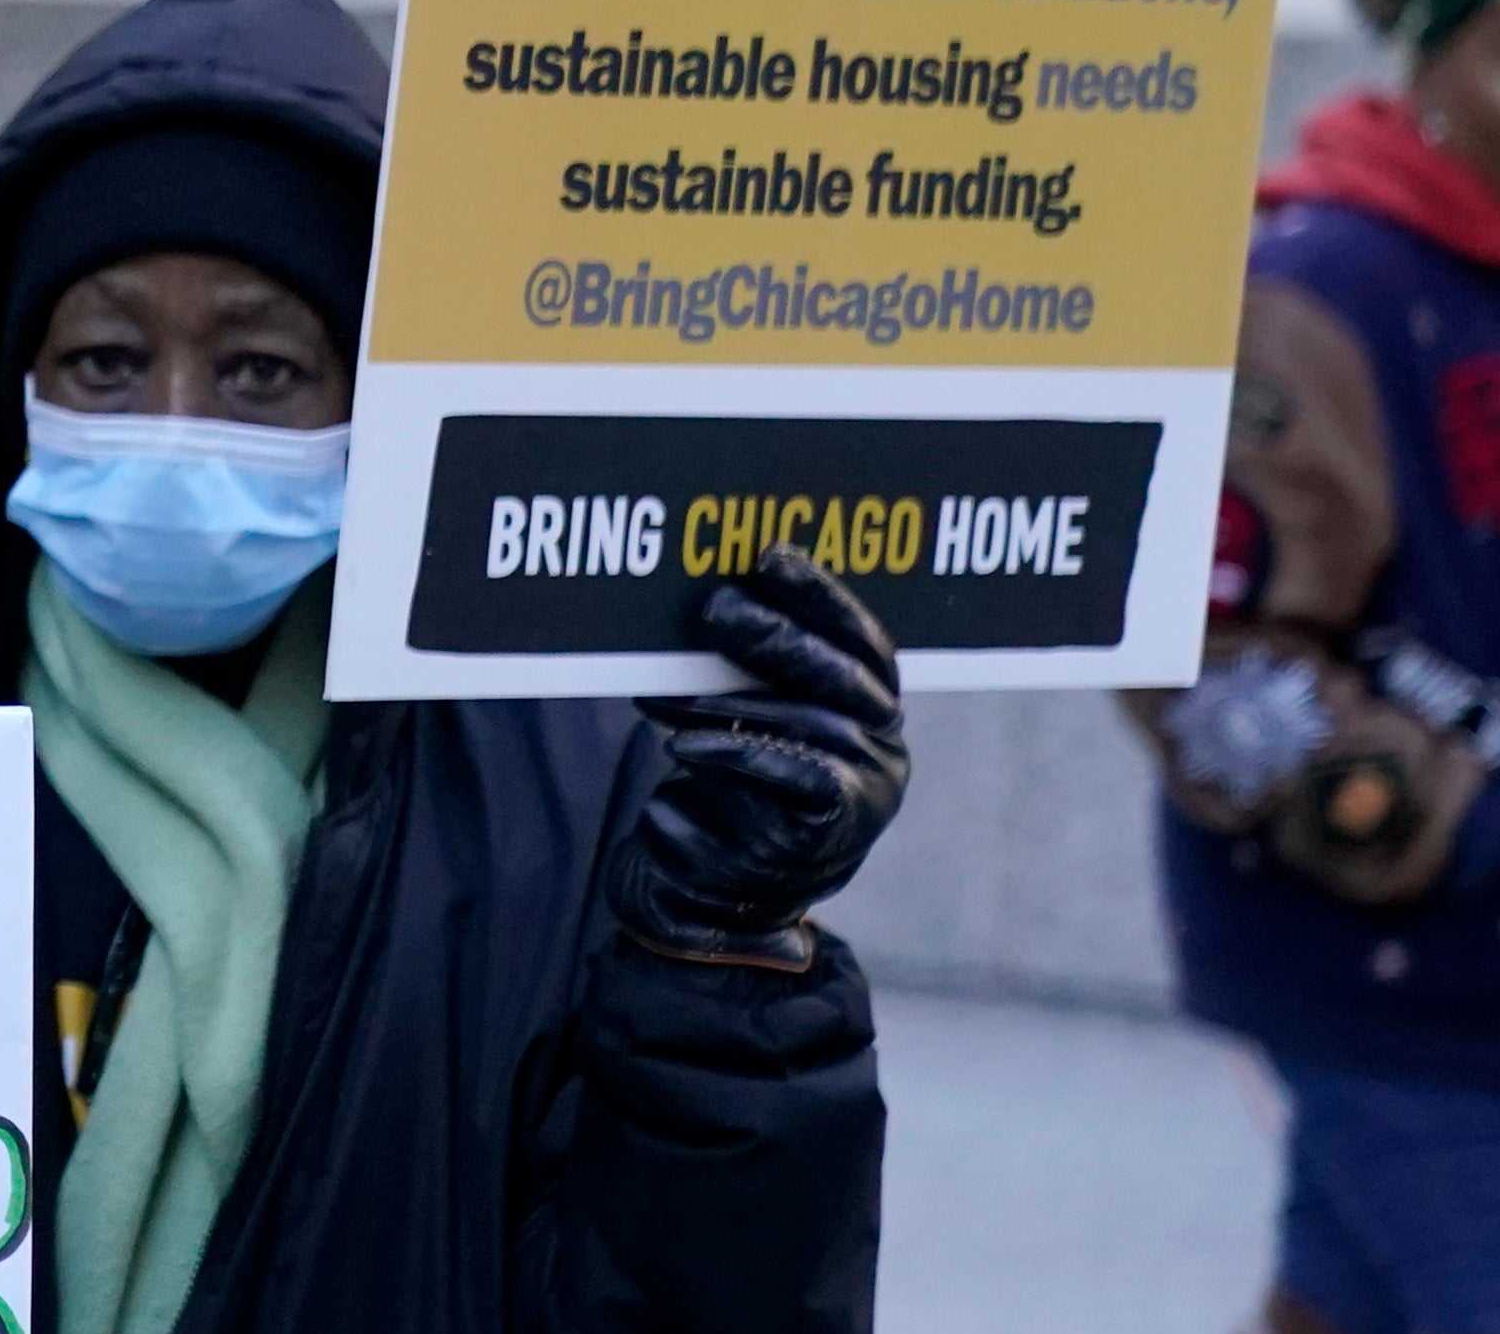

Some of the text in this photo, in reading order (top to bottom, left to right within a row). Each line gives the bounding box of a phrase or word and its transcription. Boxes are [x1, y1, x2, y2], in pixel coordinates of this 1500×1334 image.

[463, 27, 1198, 123] sustainable housing needs
[560, 146, 1082, 238] sustainble funding.
[523, 259, 1095, 347] @BringChicagoHome
[487, 495, 666, 579] BRING
[933, 496, 1090, 578] HOME
